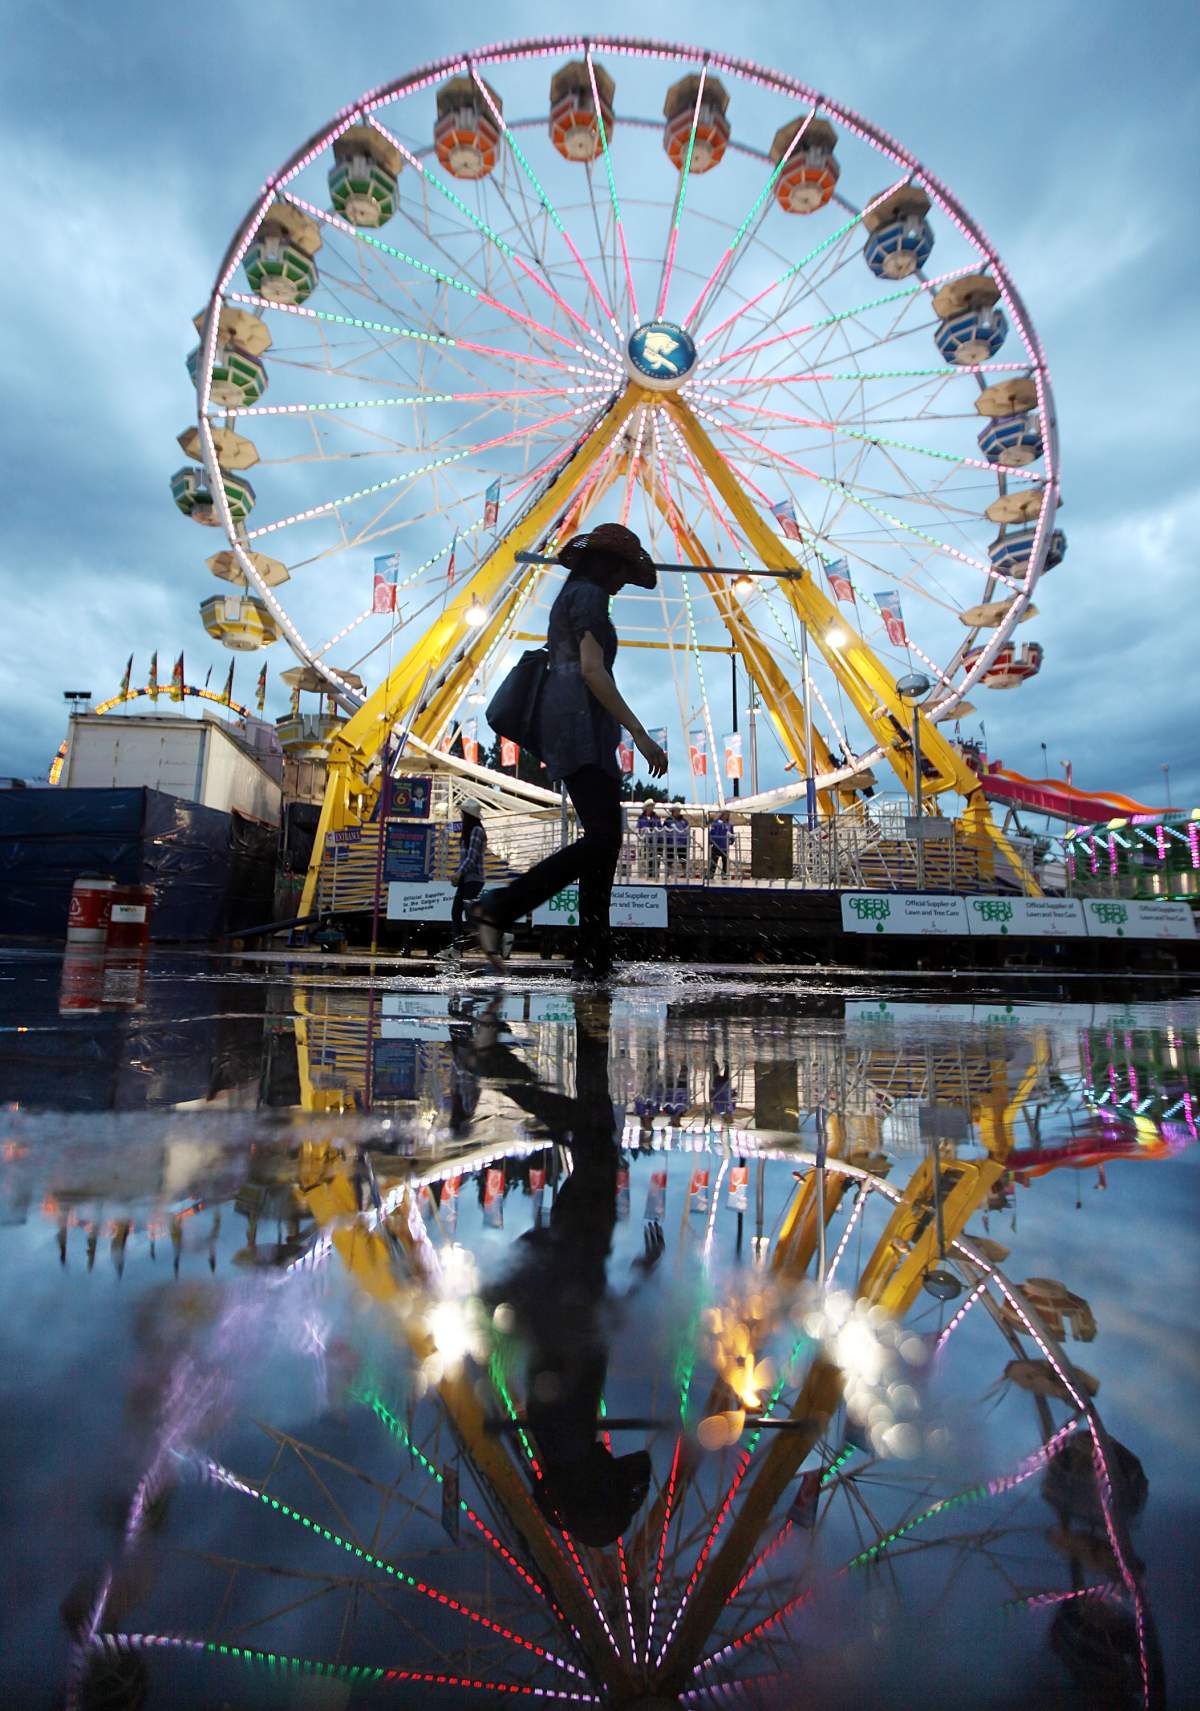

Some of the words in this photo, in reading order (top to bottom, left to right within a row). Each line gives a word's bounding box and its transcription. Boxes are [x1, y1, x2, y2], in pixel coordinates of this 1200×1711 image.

[396, 792, 406, 803] 6
[335, 831, 360, 842] ENTRANCE
[625, 892, 650, 900] Supplier
[848, 897, 890, 910] GREEN
[973, 900, 1012, 912] GREEN
[1091, 903, 1126, 914] GREEN
[857, 908, 890, 920] DROP
[982, 910, 1013, 922] DROP
[1099, 912, 1128, 924] DROP
